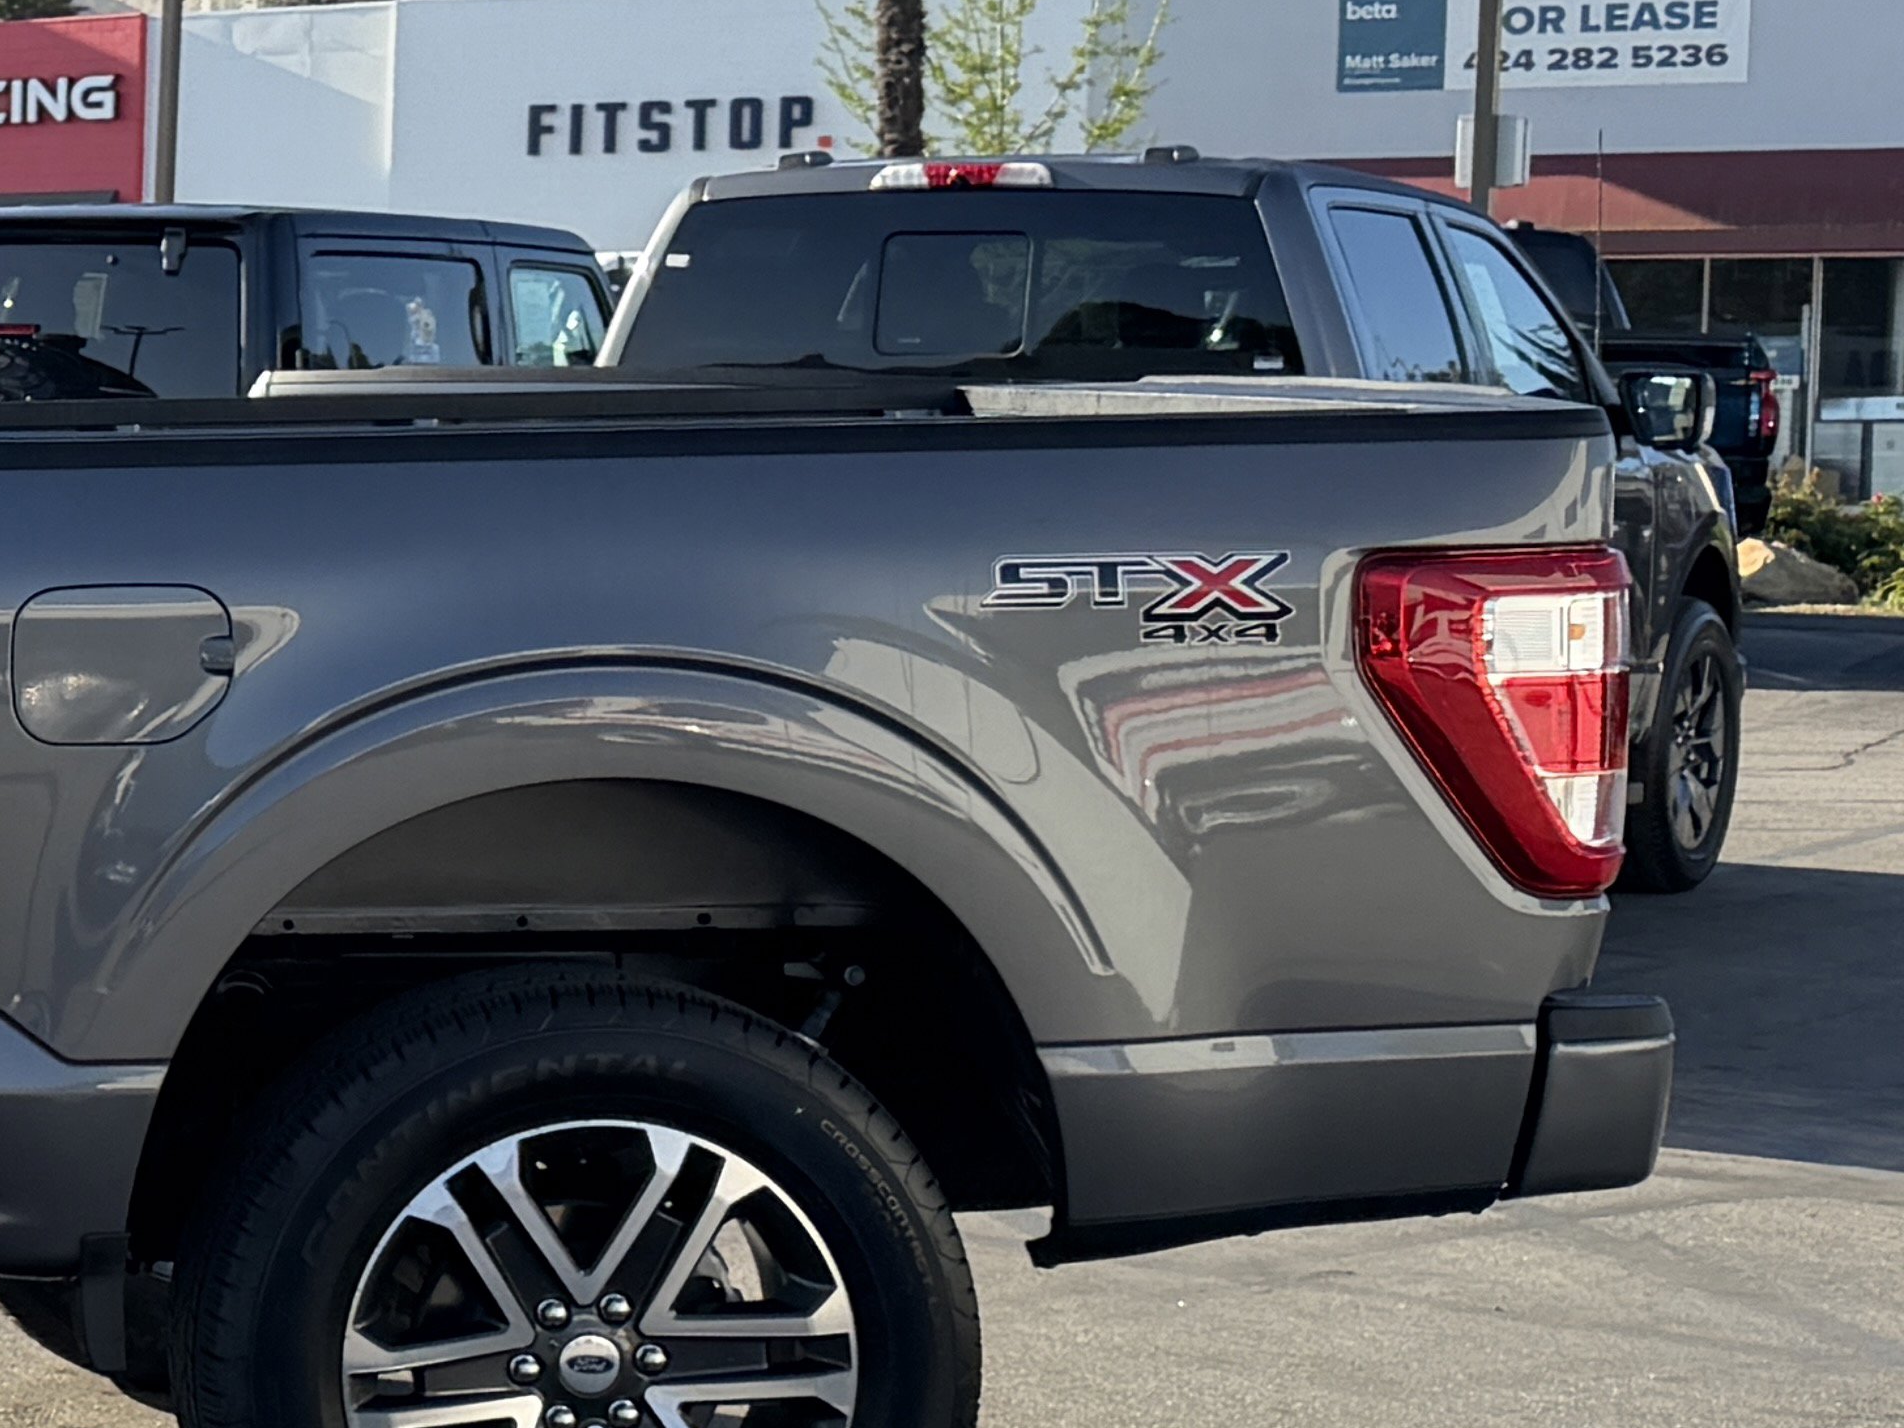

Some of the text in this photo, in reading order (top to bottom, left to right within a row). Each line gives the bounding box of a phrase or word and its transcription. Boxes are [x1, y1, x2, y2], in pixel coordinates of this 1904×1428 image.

[1345, 1, 1397, 20] beta
[1502, 0, 1720, 35] OR LEASE
[1345, 54, 1384, 70] Matt
[1547, 46, 1619, 70] 282
[1631, 43, 1729, 68] 5236
[980, 550, 1296, 622] STX
